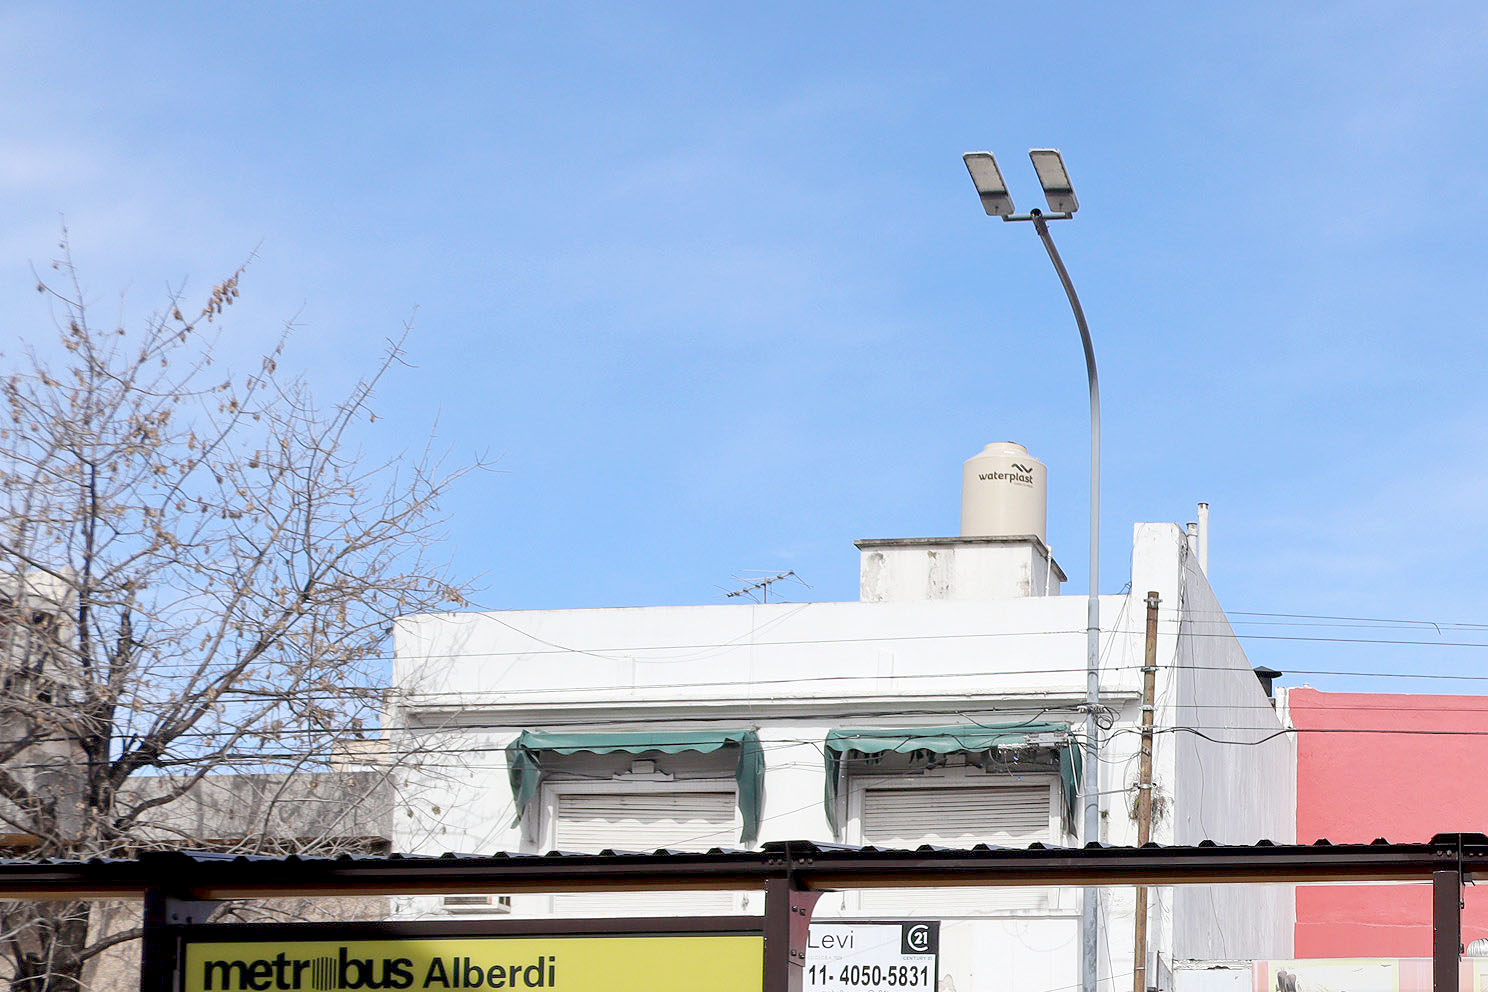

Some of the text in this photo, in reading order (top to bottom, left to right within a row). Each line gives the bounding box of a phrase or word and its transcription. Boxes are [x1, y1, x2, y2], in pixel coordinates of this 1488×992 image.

[978, 471, 1033, 484] waterplast
[807, 929, 854, 949] Levi
[422, 956, 556, 989] Alberdi
[808, 965, 928, 986] 11- 4050-5831
